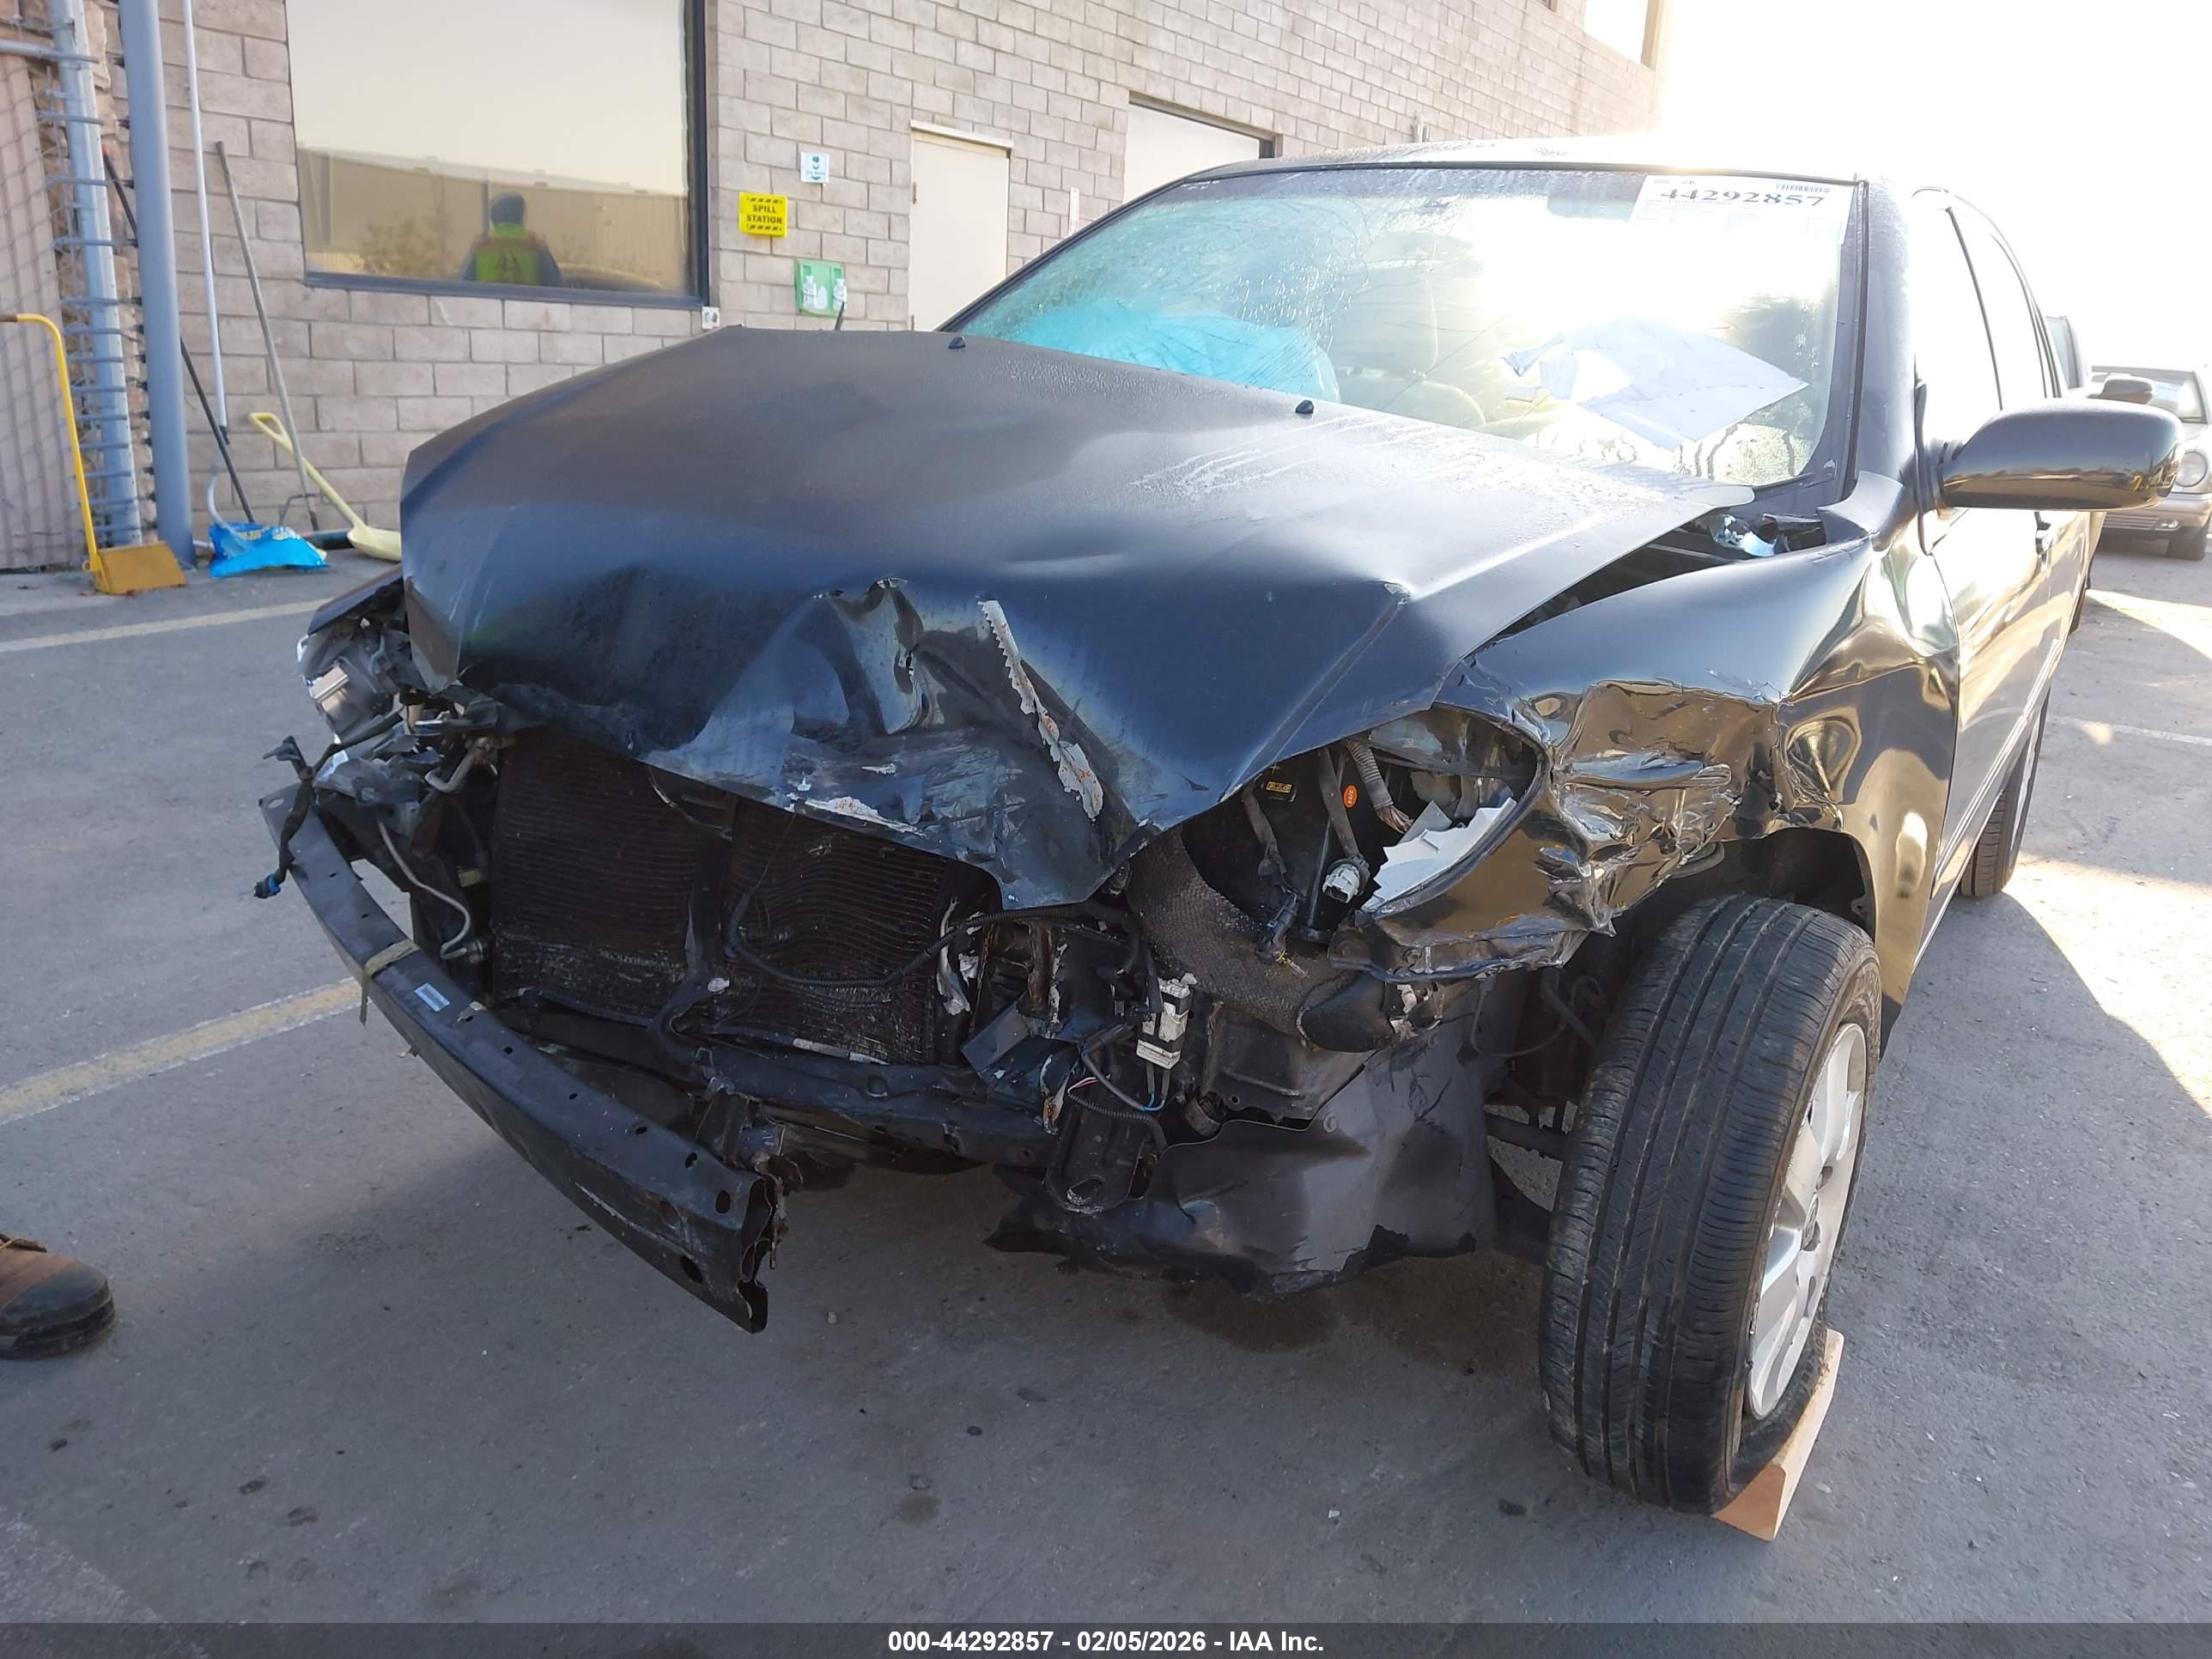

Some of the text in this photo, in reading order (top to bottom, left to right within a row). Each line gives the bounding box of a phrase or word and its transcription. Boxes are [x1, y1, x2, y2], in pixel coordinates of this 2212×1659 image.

[1660, 188, 1825, 207] 44292857
[752, 204, 777, 214] SPILL
[746, 215, 783, 224] STATION
